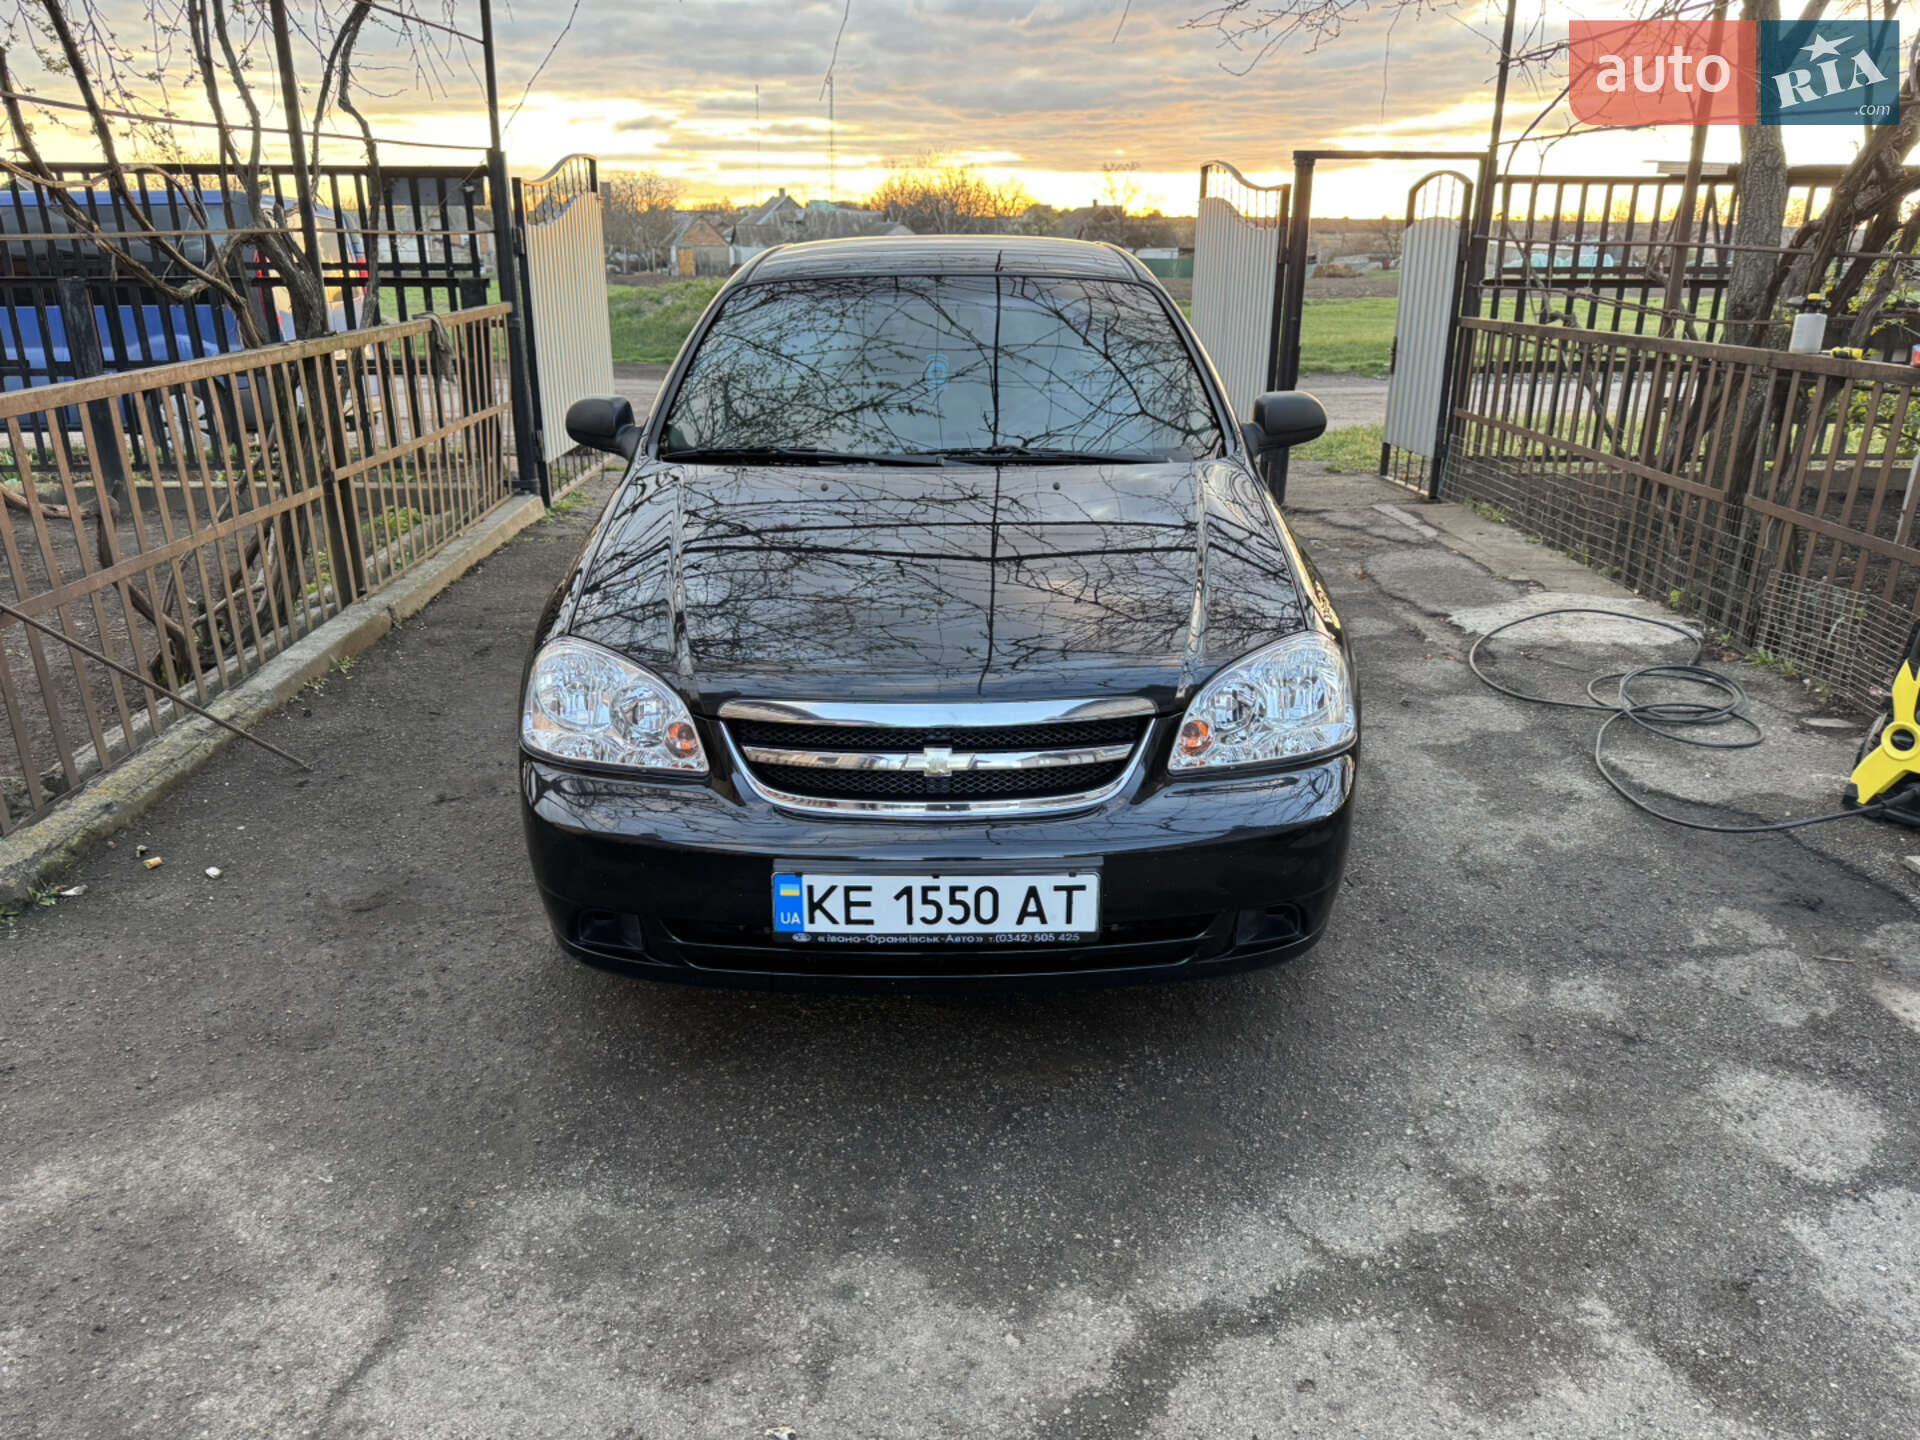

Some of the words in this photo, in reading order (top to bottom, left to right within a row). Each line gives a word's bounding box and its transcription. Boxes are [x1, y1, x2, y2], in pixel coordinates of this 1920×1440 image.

[806, 885, 875, 925] KE
[893, 885, 1000, 925] 1550
[1015, 885, 1087, 925] AT
[781, 912, 802, 925] UA
